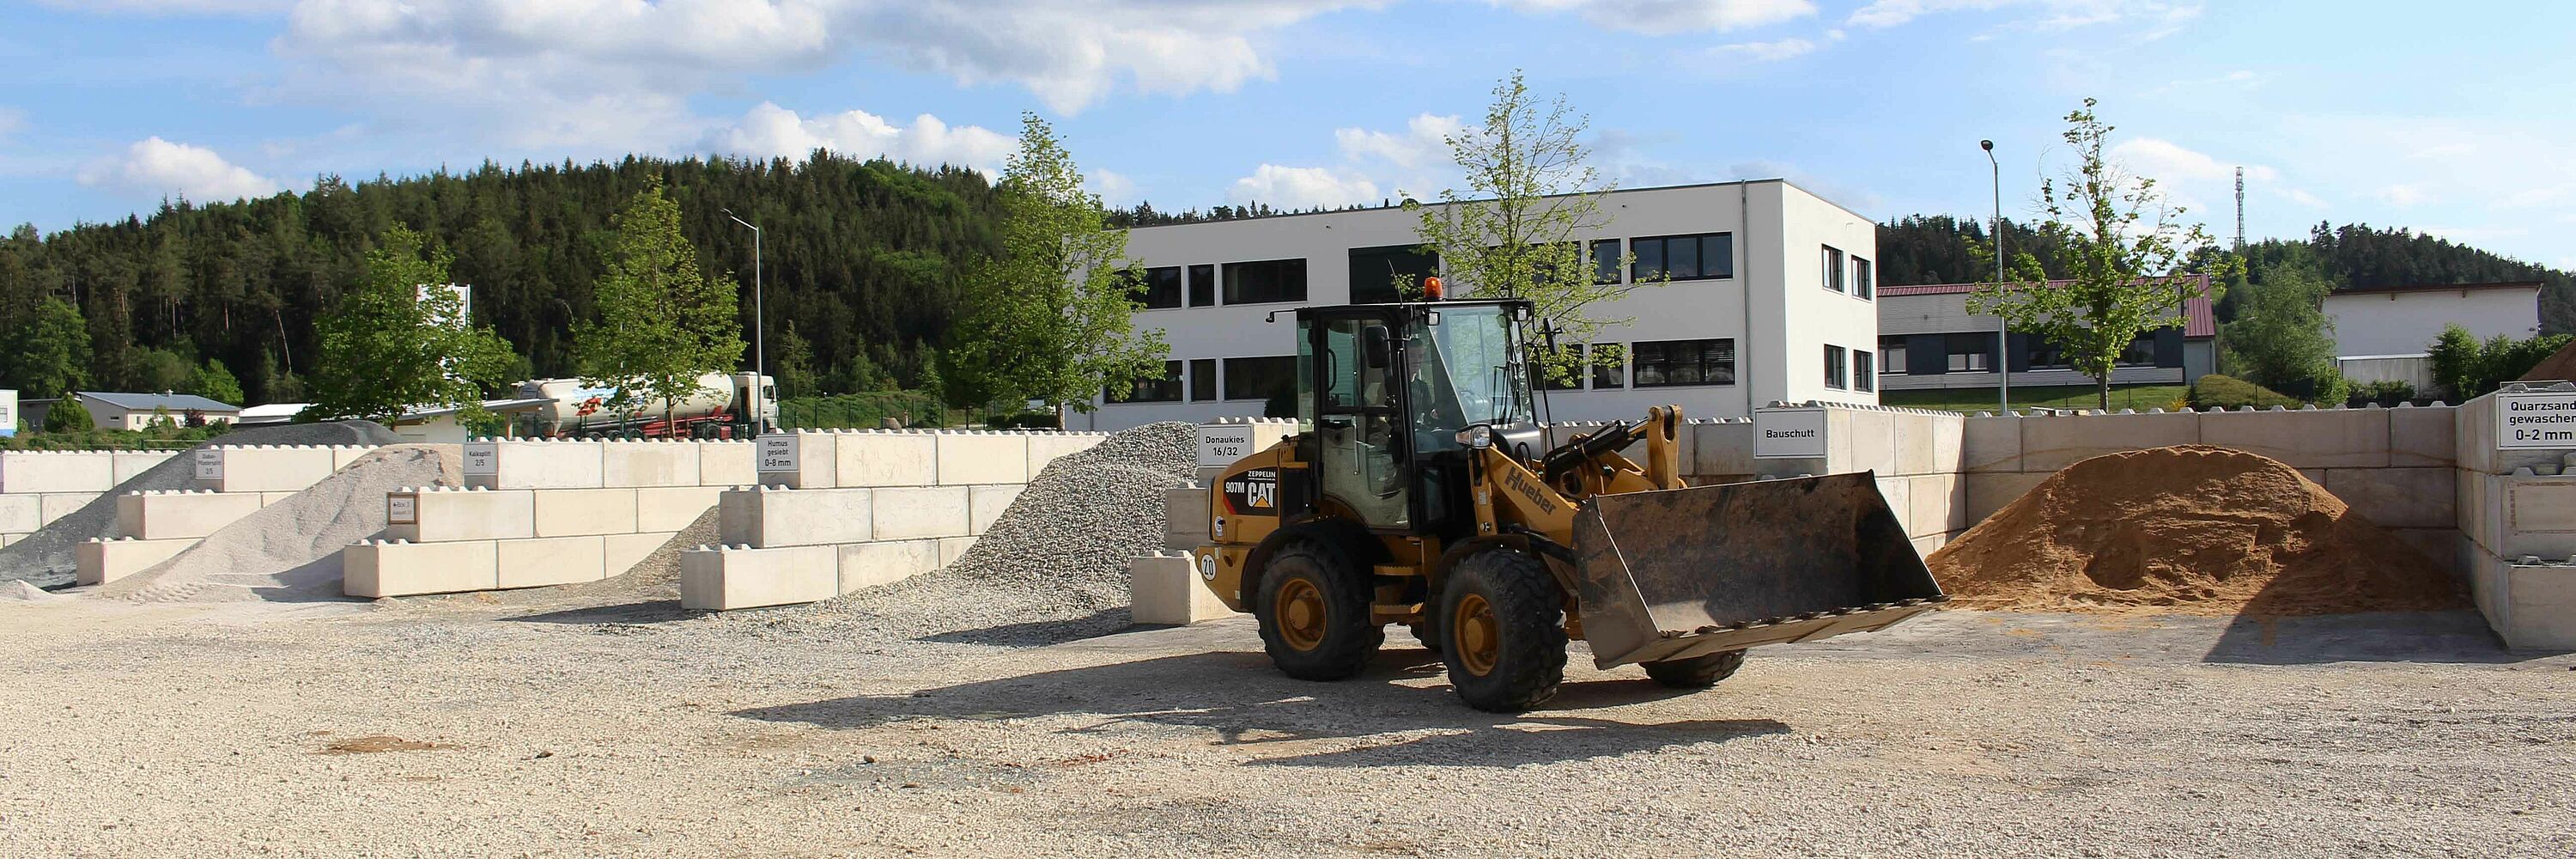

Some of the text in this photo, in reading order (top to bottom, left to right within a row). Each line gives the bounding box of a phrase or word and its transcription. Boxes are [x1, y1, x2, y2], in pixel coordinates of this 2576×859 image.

[2511, 400, 2576, 411] Quarzsand
[1766, 430, 1814, 438] Bauschutt
[2516, 429, 2573, 441] 0-2 mm
[1206, 436, 1245, 444] Donaukies
[1212, 446, 1238, 457] 16/32
[764, 459, 777, 467] 0-8
[1225, 481, 1245, 494] 907M
[1504, 466, 1557, 515] Hueber
[1248, 482, 1276, 508] CAT
[1204, 559, 1213, 576] 20
